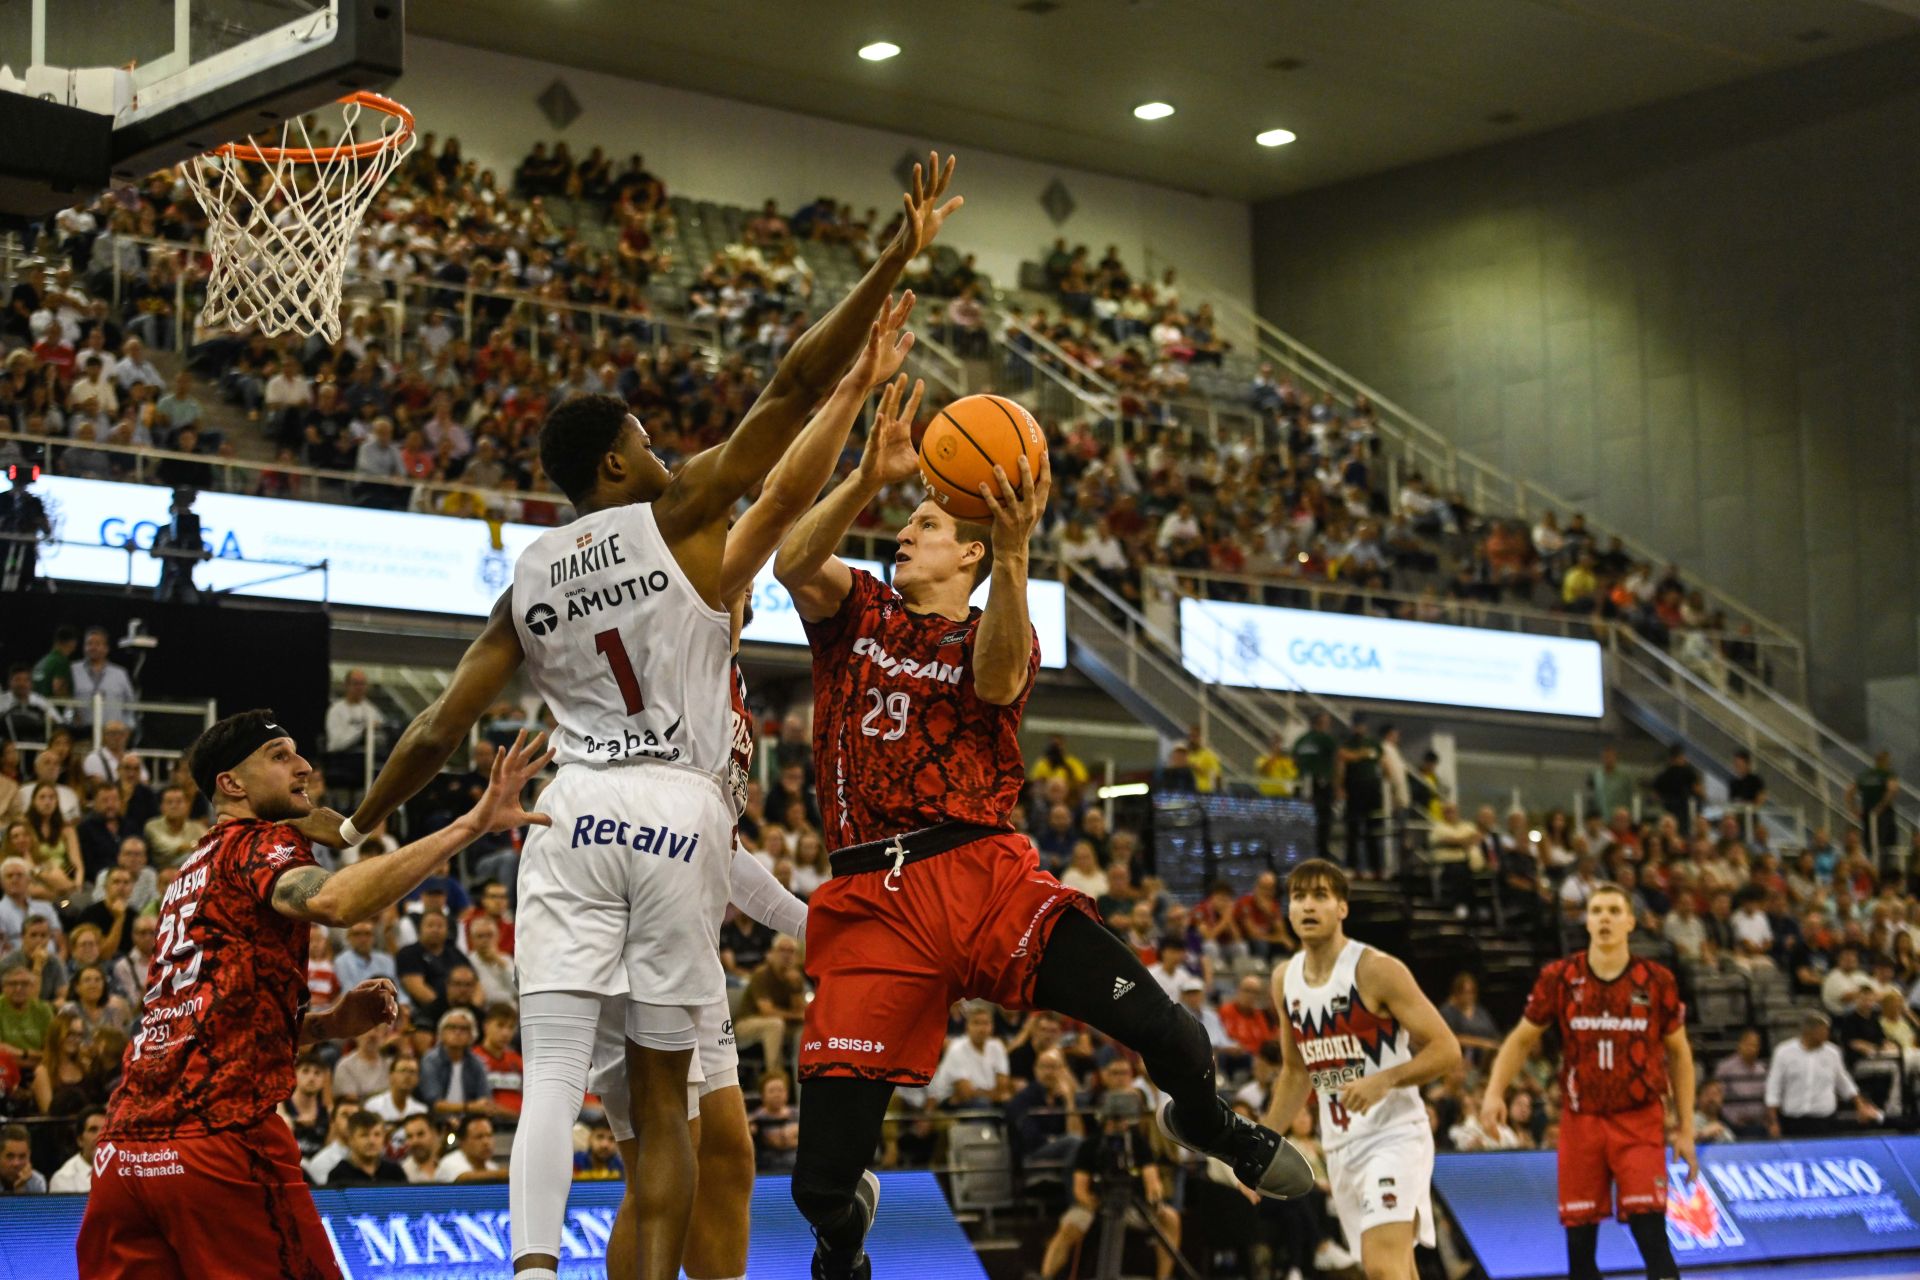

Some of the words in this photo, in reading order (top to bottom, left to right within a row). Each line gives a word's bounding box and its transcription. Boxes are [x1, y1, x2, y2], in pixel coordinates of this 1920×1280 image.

[551, 533, 625, 588] DIAKITE
[565, 587, 586, 598] GRUPO
[568, 570, 668, 621] AMUTIO
[595, 627, 645, 716] 1
[861, 687, 911, 741] 29
[572, 814, 700, 863] Recalvi
[160, 865, 208, 911] PULEVA
[1113, 980, 1136, 1001] adidas
[828, 1037, 872, 1052] asisa
[1598, 1039, 1614, 1071] 11
[1310, 1063, 1365, 1088] osner
[1329, 1101, 1351, 1132] 4
[118, 1165, 132, 1177] de
[134, 1162, 185, 1178] Granada
[119, 1148, 178, 1165] Diputación
[1707, 1157, 1883, 1201] MANZANO
